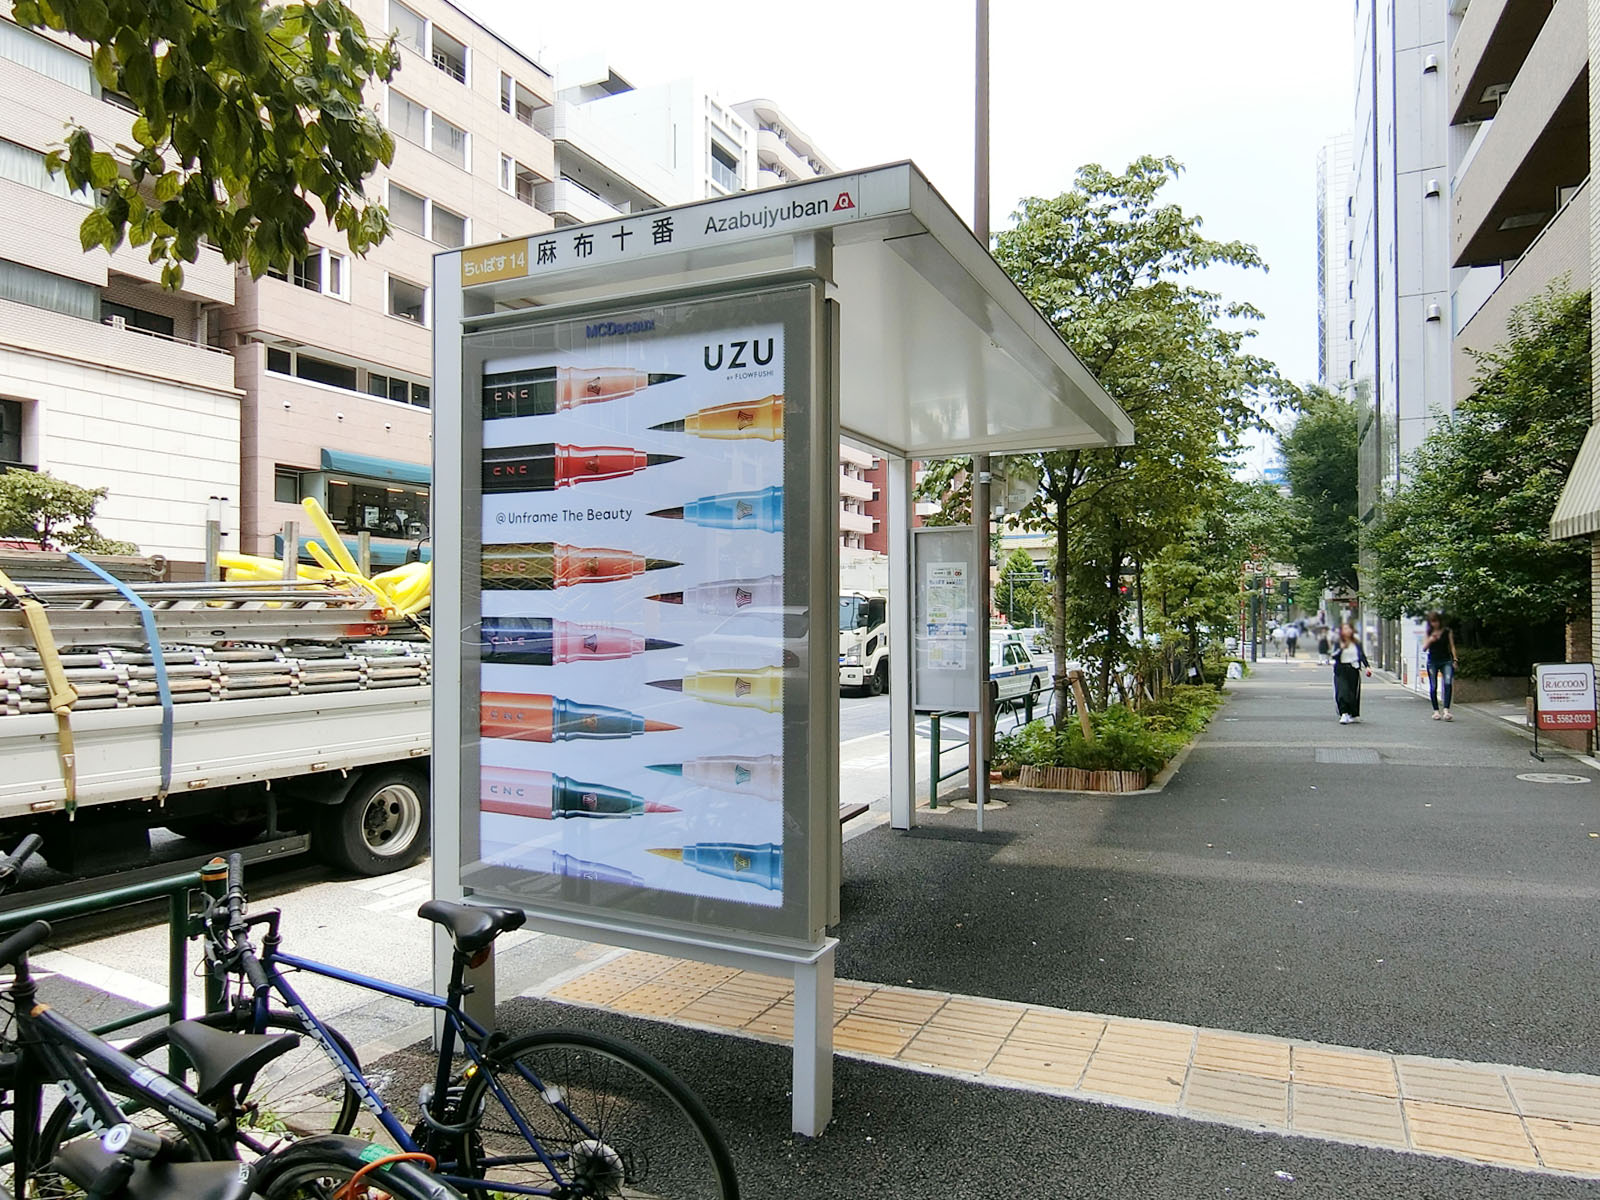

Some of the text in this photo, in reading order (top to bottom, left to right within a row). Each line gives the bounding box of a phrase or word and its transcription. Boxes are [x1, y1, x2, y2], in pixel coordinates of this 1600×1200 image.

[704, 199, 828, 235] Azabujyuban
[536, 216, 674, 265] 麻布十番
[510, 251, 525, 269] 14
[704, 338, 774, 371] UZU
[735, 370, 774, 380] FLOWFUSHI
[494, 389, 528, 401] CNC
[492, 465, 527, 476] CNC
[562, 509, 584, 521] The
[587, 508, 632, 521] Beauty
[1545, 680, 1585, 689] RACCOON
[1542, 714, 1555, 723] TEL
[490, 784, 525, 797] CNC
